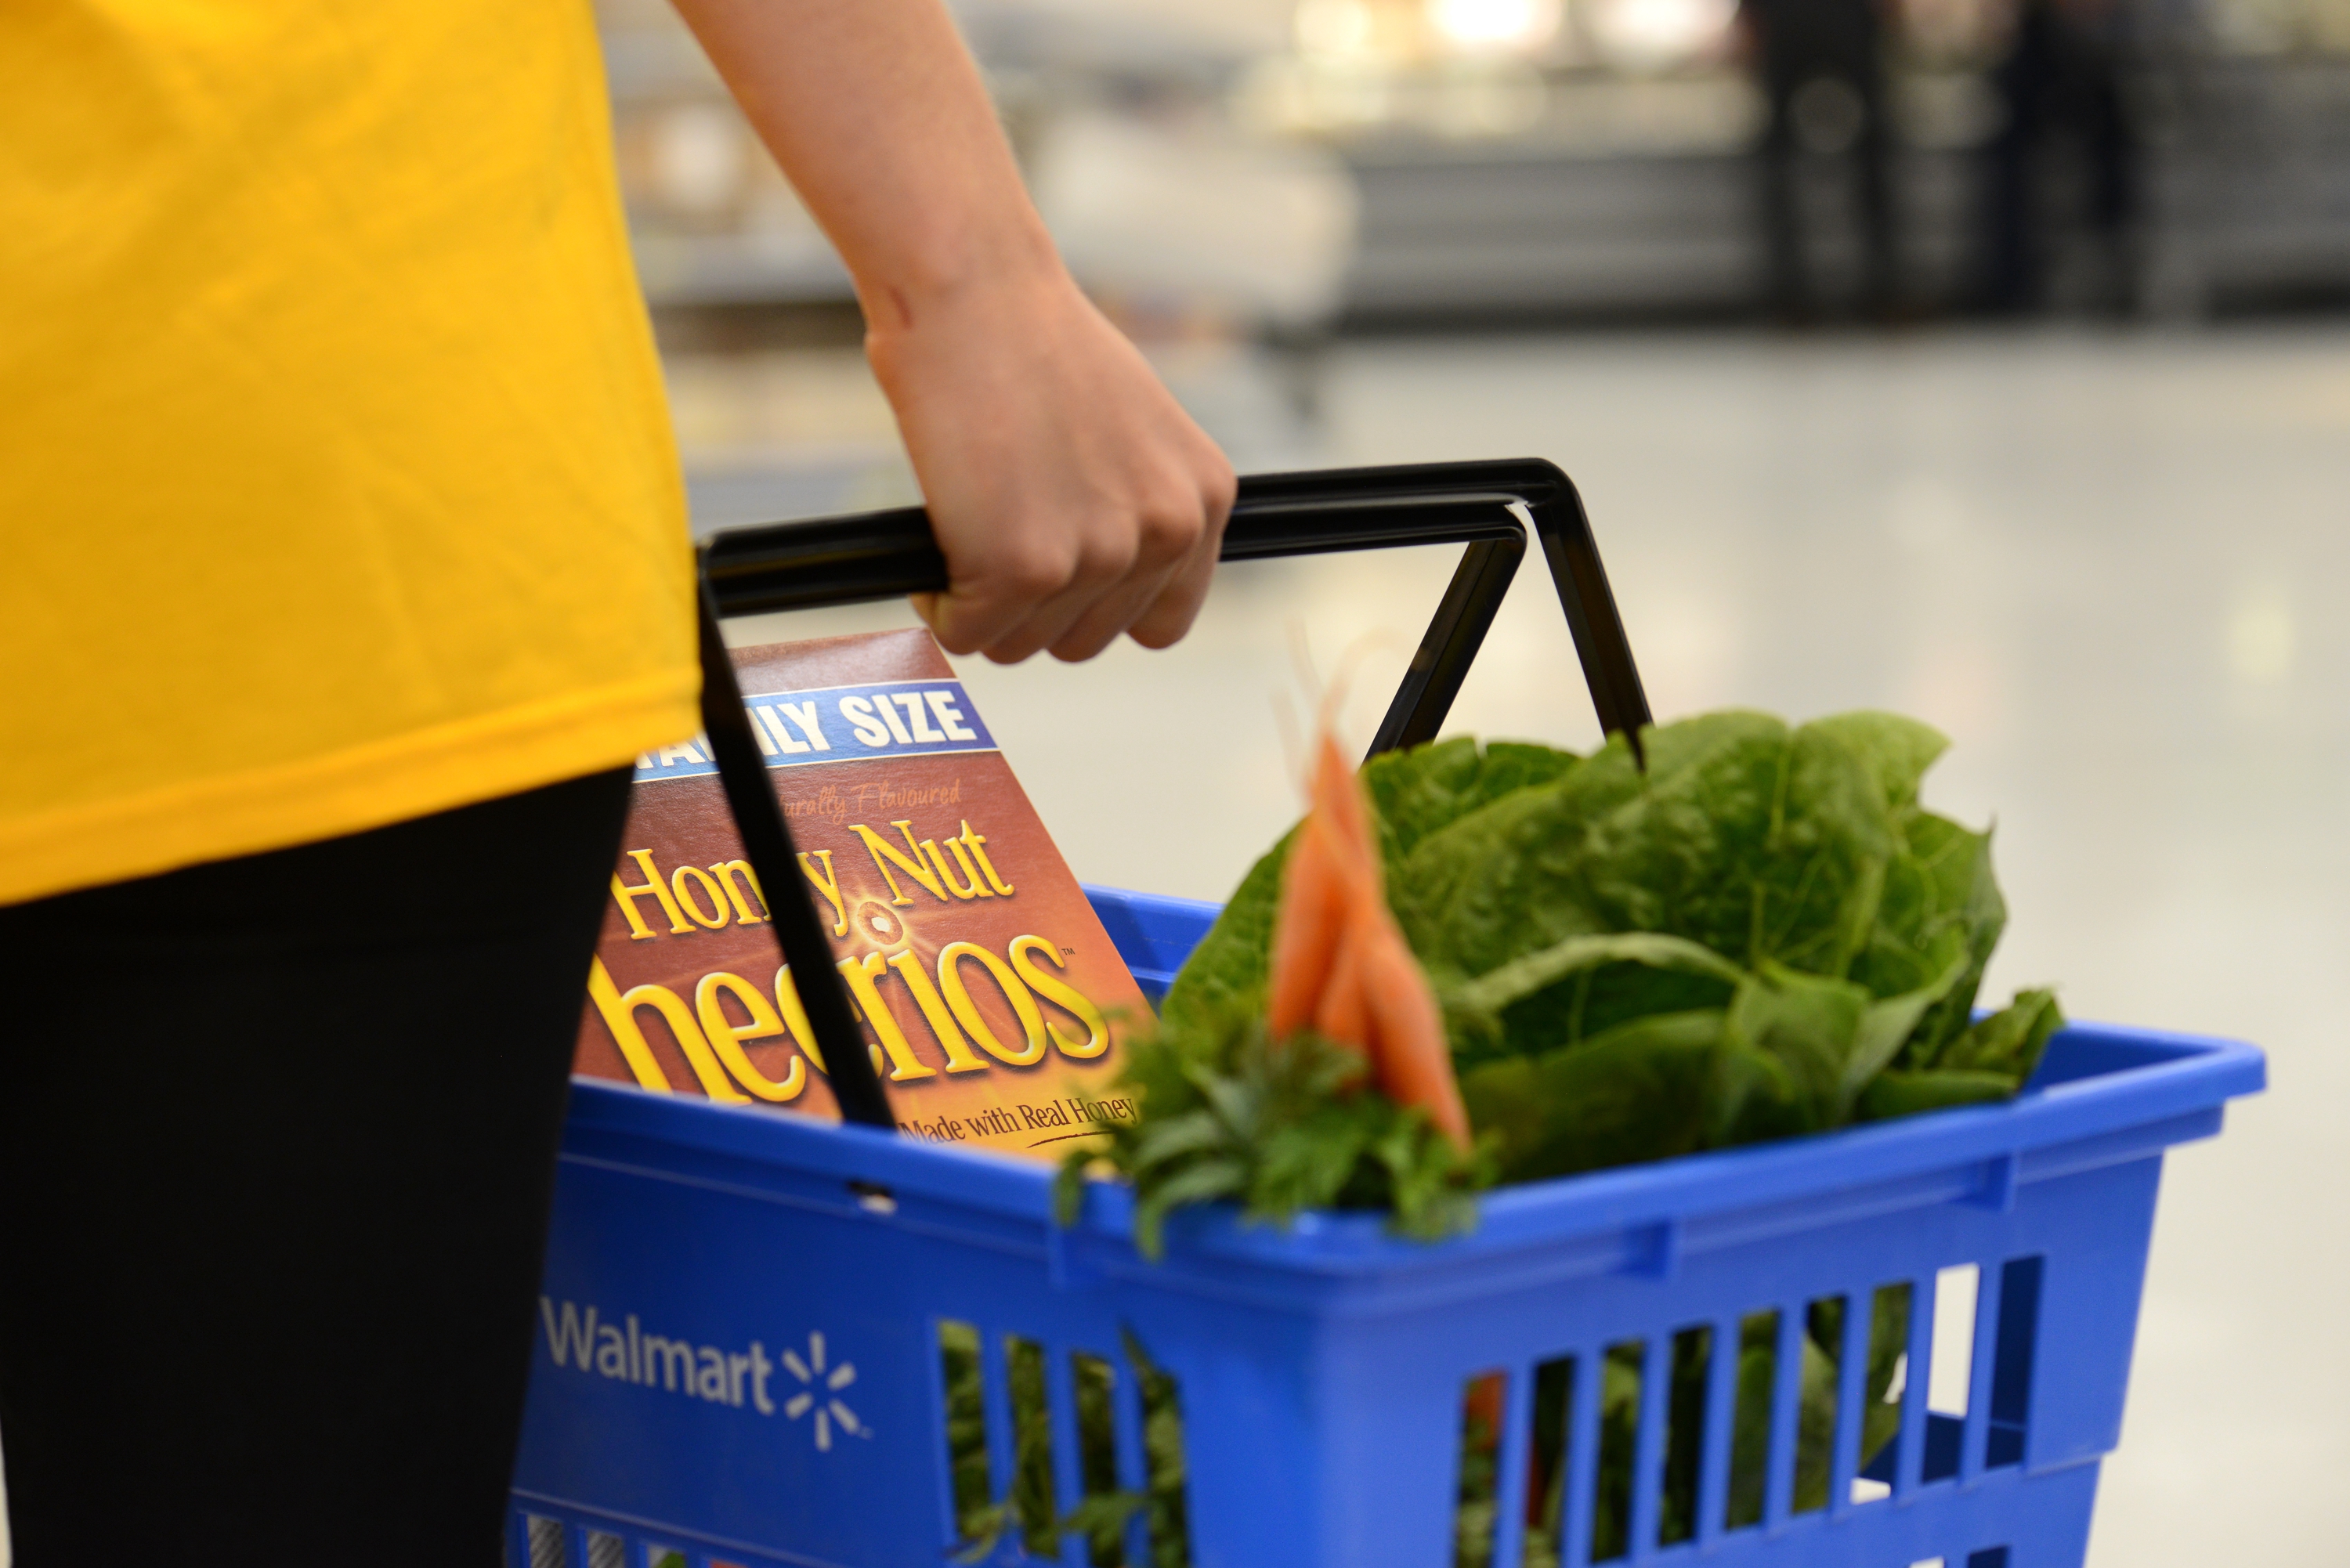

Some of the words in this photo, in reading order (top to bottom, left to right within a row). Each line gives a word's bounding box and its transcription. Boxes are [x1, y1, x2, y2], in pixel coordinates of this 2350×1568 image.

[634, 701, 830, 769] AILY
[839, 691, 978, 748] SIZE
[780, 784, 848, 825] urally
[850, 778, 962, 813] Flavoured
[609, 848, 849, 939] Hony
[848, 819, 1015, 906] Nut
[588, 934, 1109, 1105] herios
[898, 1115, 966, 1145] Made
[964, 1107, 1022, 1137] with
[1016, 1099, 1072, 1130] Real
[1065, 1097, 1137, 1125] Honey
[540, 1295, 777, 1416] Walmart
